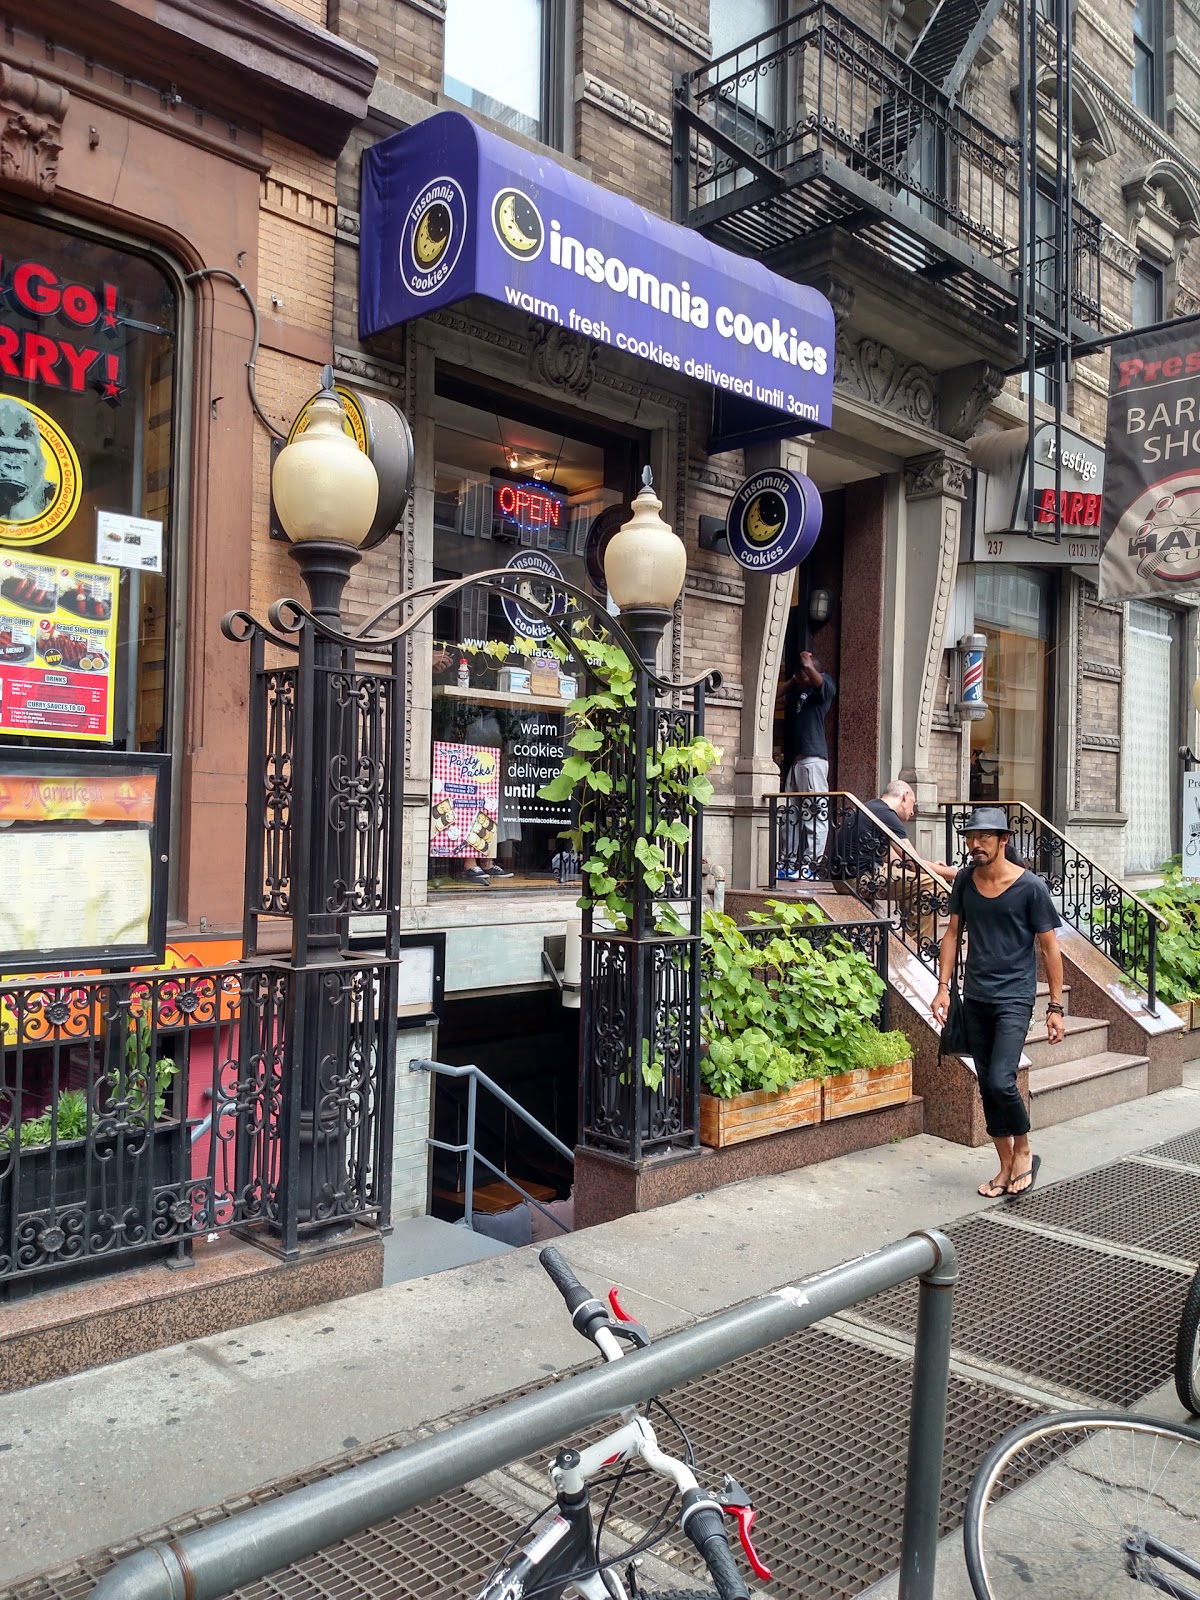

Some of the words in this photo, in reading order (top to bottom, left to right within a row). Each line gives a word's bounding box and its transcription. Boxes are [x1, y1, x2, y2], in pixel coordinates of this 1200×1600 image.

[411, 185, 455, 221] insomnia
[411, 263, 449, 290] cookies
[550, 219, 709, 329] insomnia
[715, 306, 827, 376] cookies
[504, 285, 564, 327] warm,
[568, 308, 611, 344] fresh
[616, 332, 681, 371] cookies
[684, 358, 753, 398] delivered
[756, 385, 784, 409] until
[787, 394, 819, 421] 3am!
[1127, 397, 1200, 435] BAR
[1047, 438, 1098, 481] Pestige
[740, 476, 790, 502] insomnia
[499, 486, 559, 526] OPEN
[1038, 488, 1102, 527] BARB
[740, 545, 784, 565] cookies
[987, 541, 1003, 555] 237
[1068, 543, 1087, 558] (212)
[512, 556, 556, 578] insomnia
[13, 617, 34, 627] CURRY
[42, 621, 49, 629] 7
[56, 623, 75, 632] Grand
[75, 625, 89, 633] Slam
[89, 627, 108, 636] CURRY
[514, 618, 553, 637] cookies
[46, 655, 61, 663] MVP
[46, 675, 67, 684] DRINKS
[27, 700, 46, 708] CURRY
[47, 702, 68, 710] SAUCES
[520, 723, 558, 736] warm
[513, 742, 564, 758] cookies
[449, 755, 480, 769] Party
[460, 763, 495, 778] Packs!
[507, 762, 562, 779] delivere
[23, 779, 104, 810] Marrakesh
[504, 784, 536, 799] until
[502, 816, 572, 825] www.insomniacookies.com
